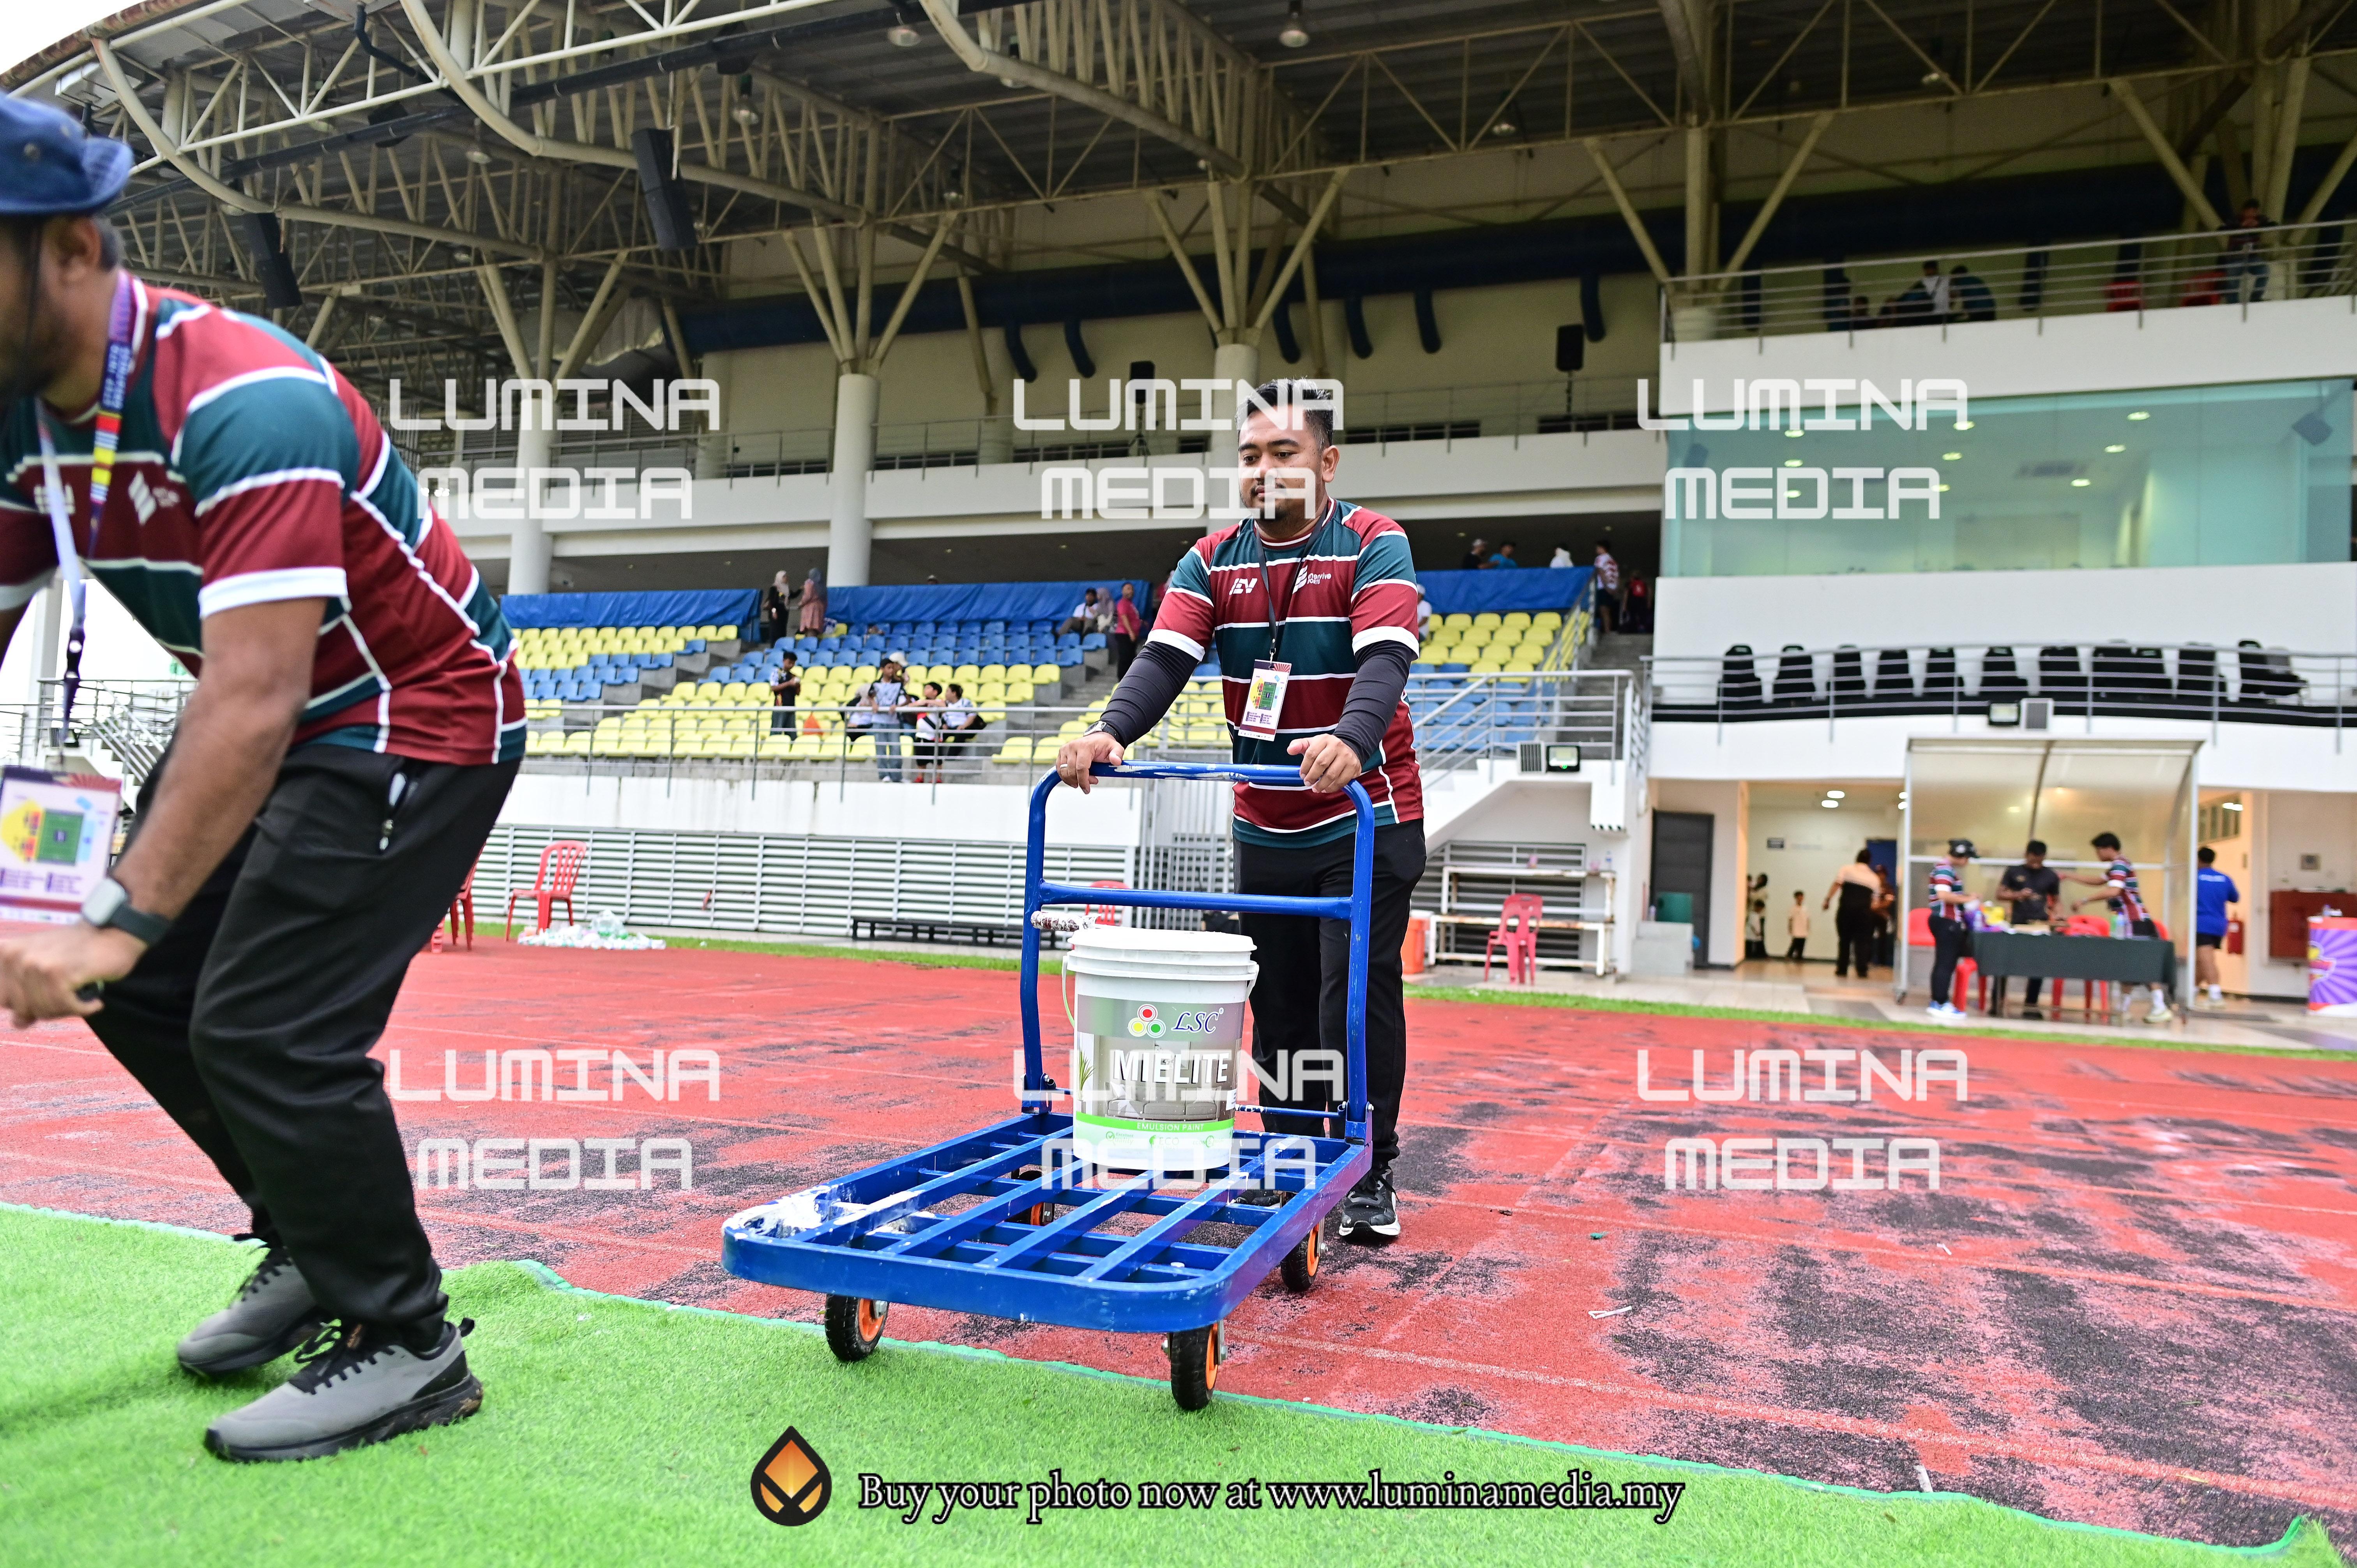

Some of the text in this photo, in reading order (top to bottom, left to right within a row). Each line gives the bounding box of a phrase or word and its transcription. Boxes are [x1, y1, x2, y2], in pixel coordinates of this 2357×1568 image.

[1113, 1049, 1230, 1084] MIELITE
[1136, 1122, 1204, 1131] EMULSION PAINT
[1159, 1137, 1179, 1145] ECO
